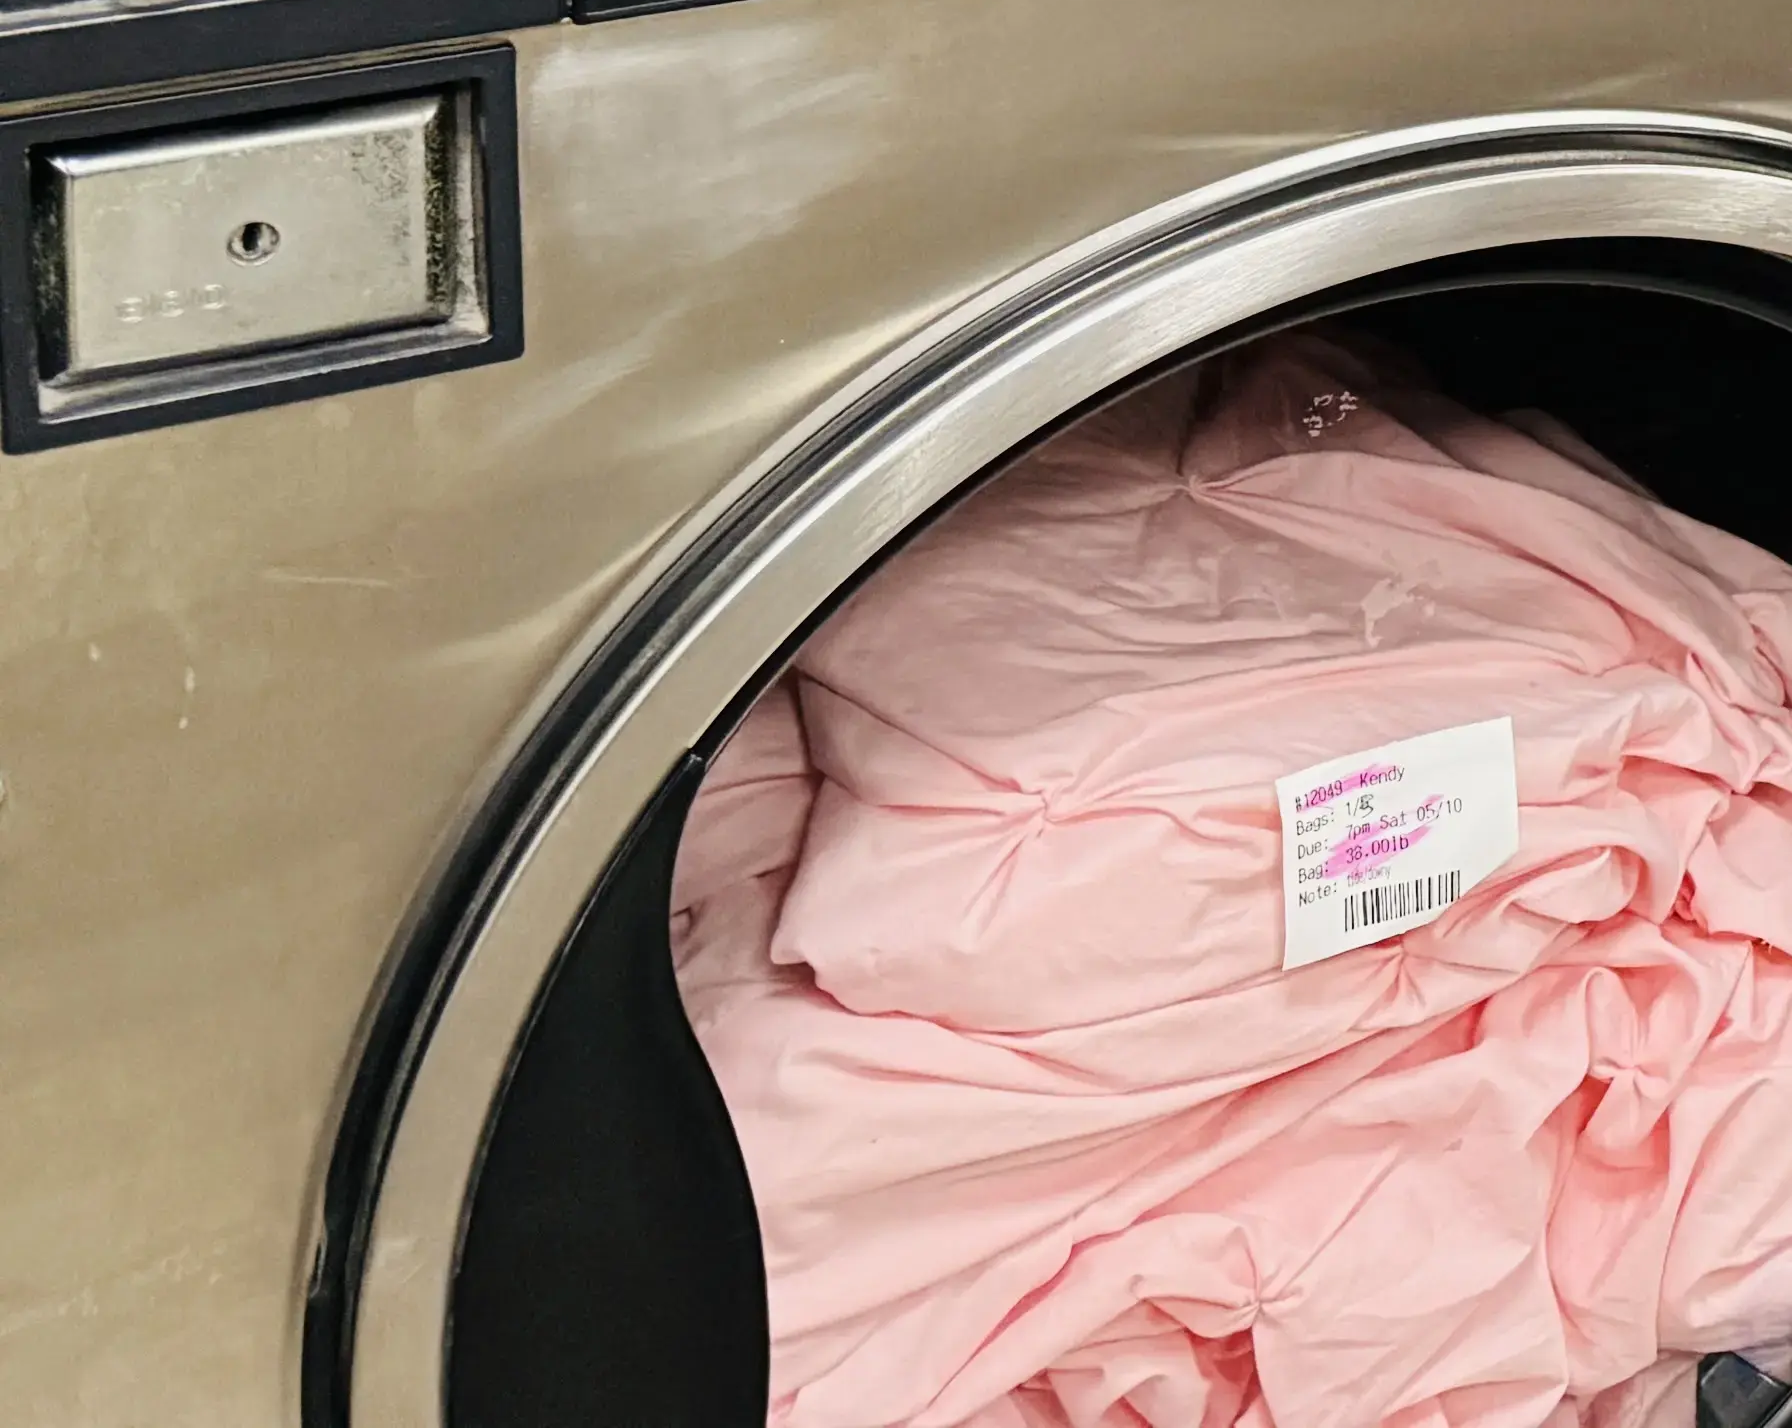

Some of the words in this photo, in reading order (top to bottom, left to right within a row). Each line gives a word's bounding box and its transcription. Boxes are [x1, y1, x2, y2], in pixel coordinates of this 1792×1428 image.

[1295, 780, 1343, 813] #12049
[1359, 766, 1405, 788] Kendy
[1296, 811, 1335, 837] Bags:
[1297, 838, 1329, 860] Due:
[1346, 822, 1371, 840] 7pm
[1380, 812, 1406, 829] Sat
[1416, 798, 1463, 821] 05/10
[1298, 863, 1329, 884] Bag:
[1298, 882, 1338, 907] Note:
